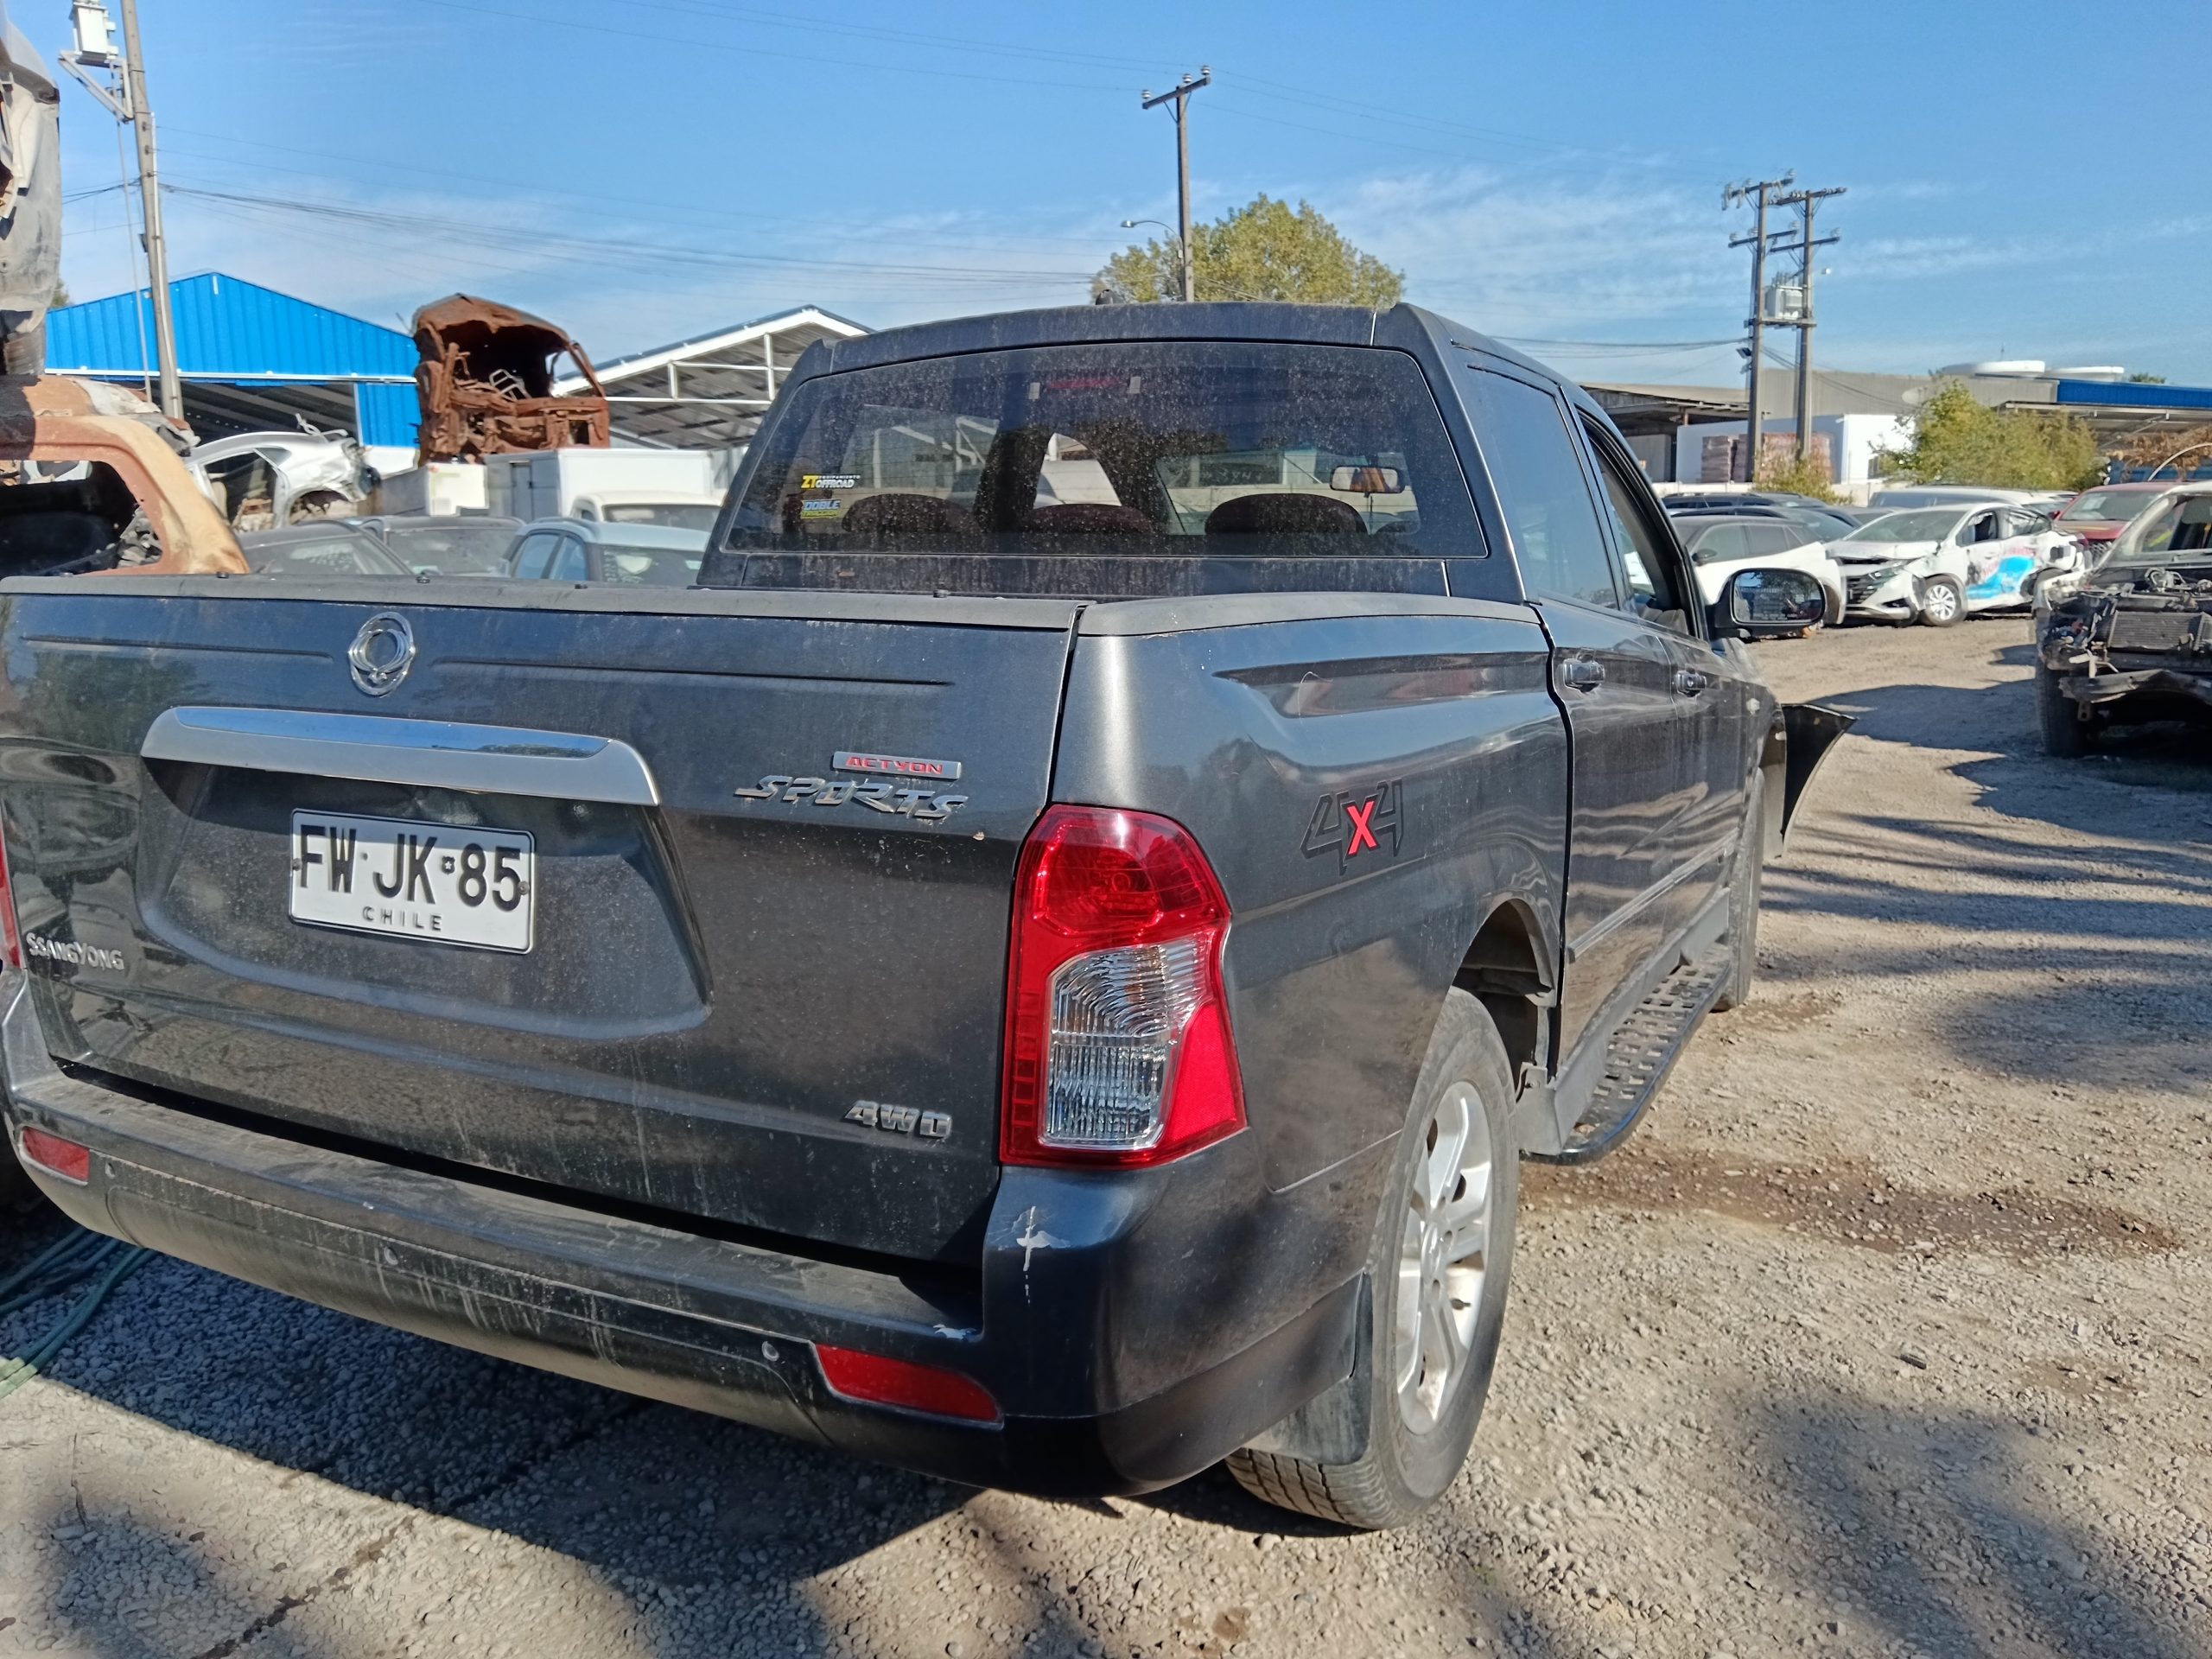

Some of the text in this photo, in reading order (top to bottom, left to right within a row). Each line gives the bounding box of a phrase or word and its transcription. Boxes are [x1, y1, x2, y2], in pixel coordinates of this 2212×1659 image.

[801, 475, 855, 488] ZT OFFROAD
[804, 500, 841, 511] DOBLE
[844, 755, 944, 775] ACTYON
[734, 774, 969, 820] SPORTS
[361, 905, 443, 932] CHILE
[843, 1099, 952, 1141] 4WD
